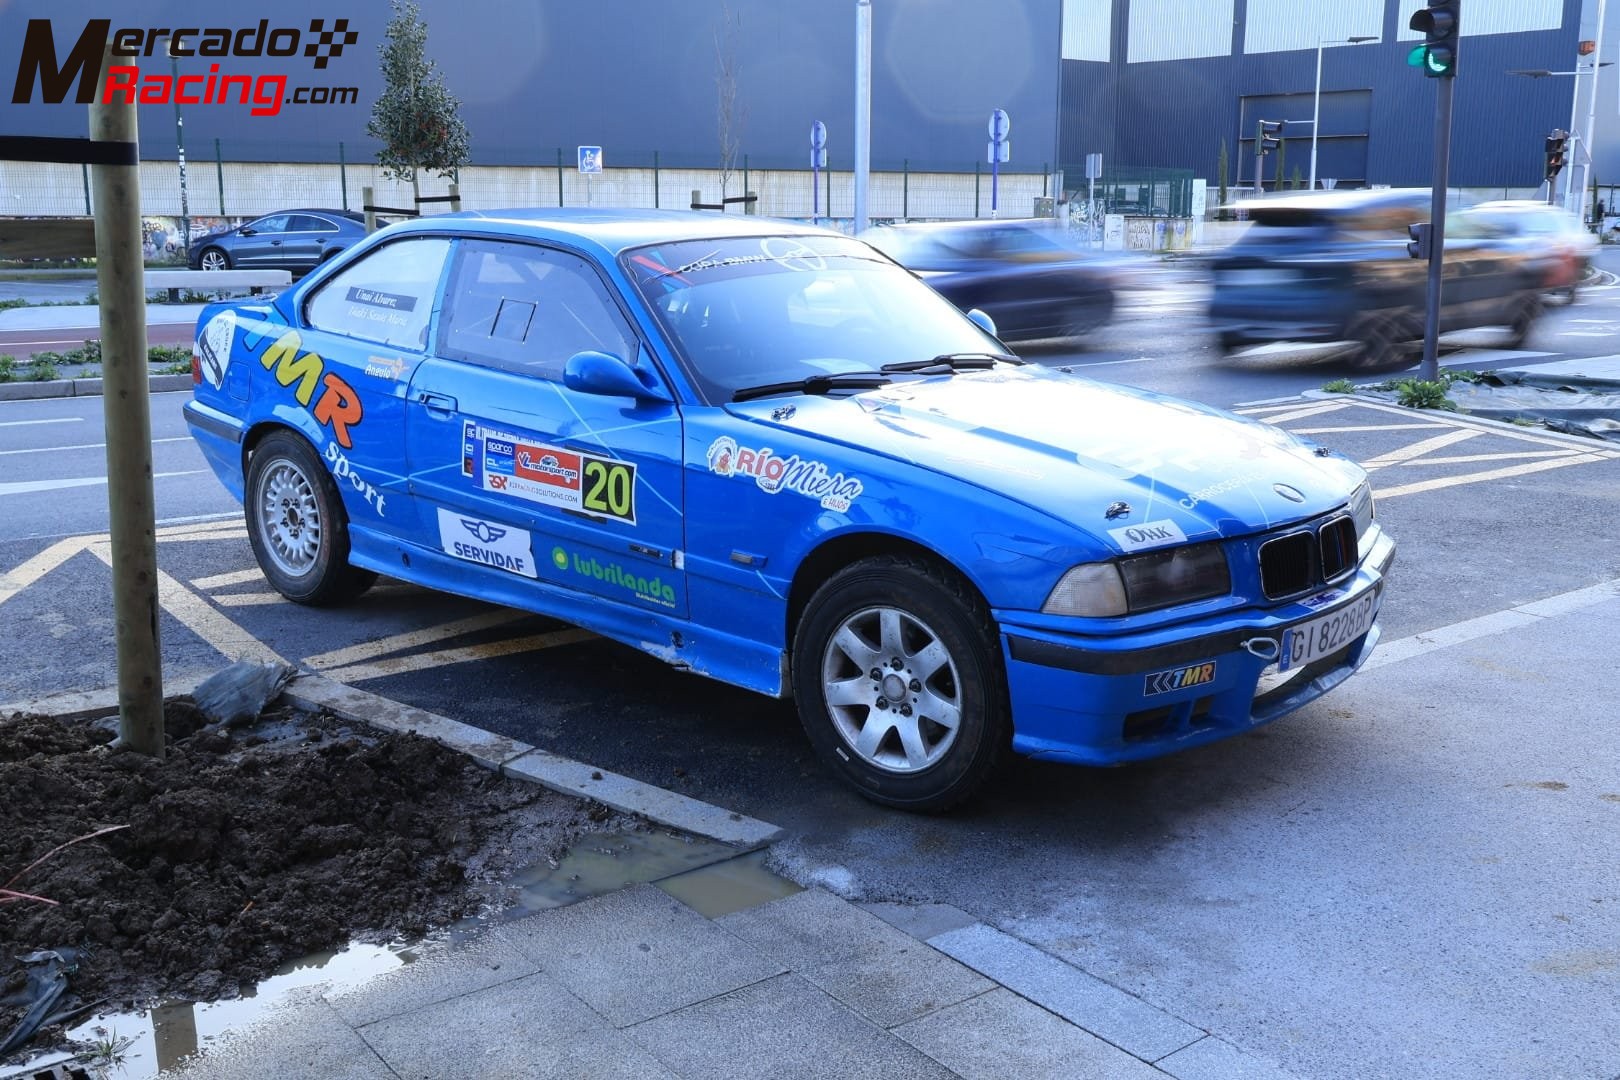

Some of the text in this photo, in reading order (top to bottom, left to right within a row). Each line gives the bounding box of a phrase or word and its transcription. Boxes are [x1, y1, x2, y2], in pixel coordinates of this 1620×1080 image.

[584, 461, 630, 516] 20
[735, 448, 784, 480] RÍO
[782, 455, 862, 500] Miera
[453, 541, 524, 572] SERVIDAF
[1292, 627, 1313, 662] GI
[1172, 664, 1213, 688] TMR
